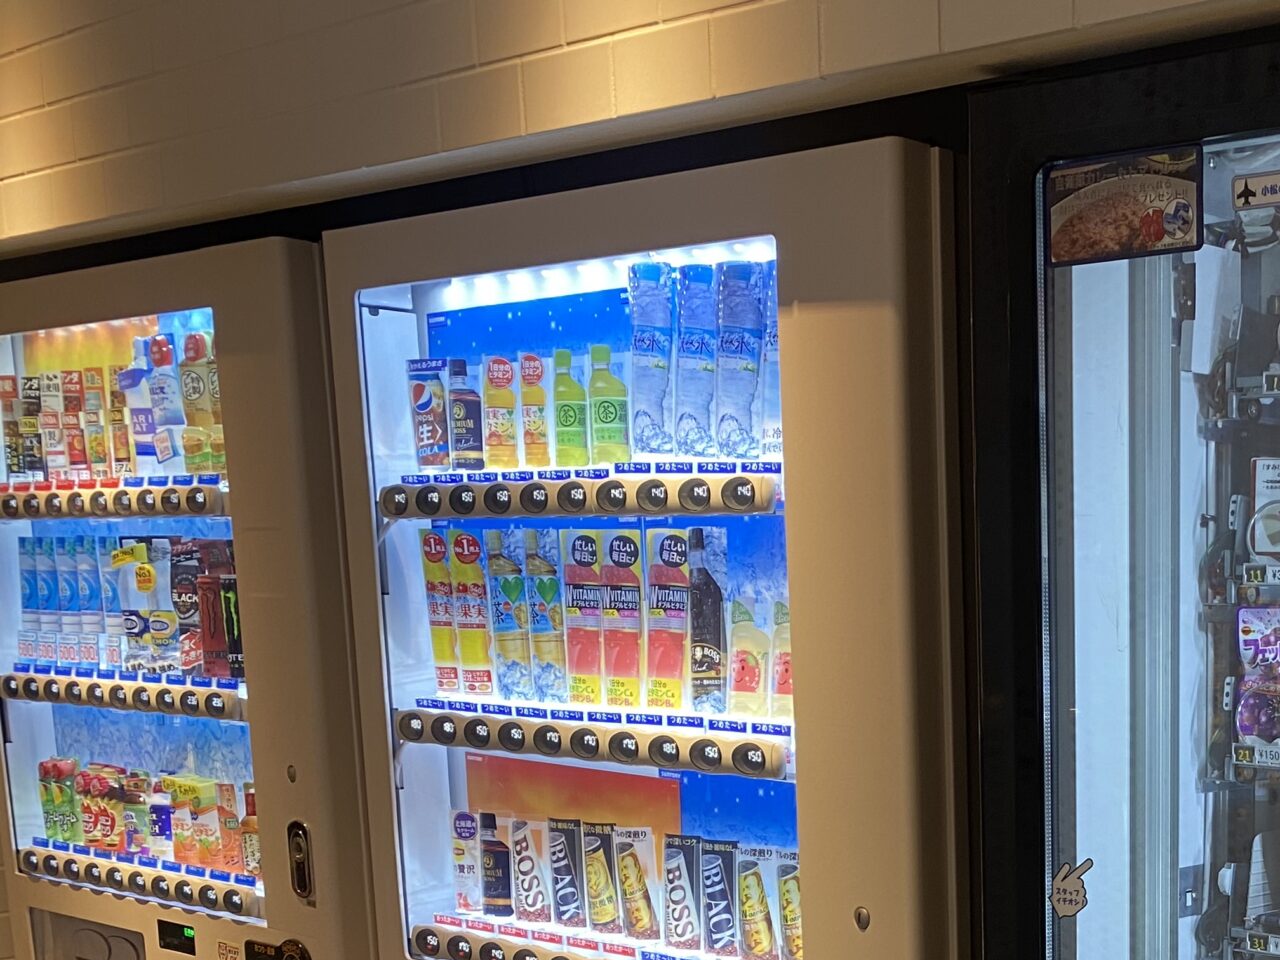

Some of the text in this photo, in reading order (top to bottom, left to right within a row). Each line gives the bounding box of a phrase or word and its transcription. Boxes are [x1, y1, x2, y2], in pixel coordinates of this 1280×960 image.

[559, 407, 575, 424] 茶
[599, 403, 616, 421] 茶
[611, 540, 635, 552] 忙しい
[1258, 750, 1280, 761] ¥150
[516, 835, 544, 912] BOSS
[550, 844, 580, 920] BLACK
[1055, 887, 1079, 897] スタッフ
[666, 864, 695, 942] BOSS
[703, 869, 736, 949] BLACK
